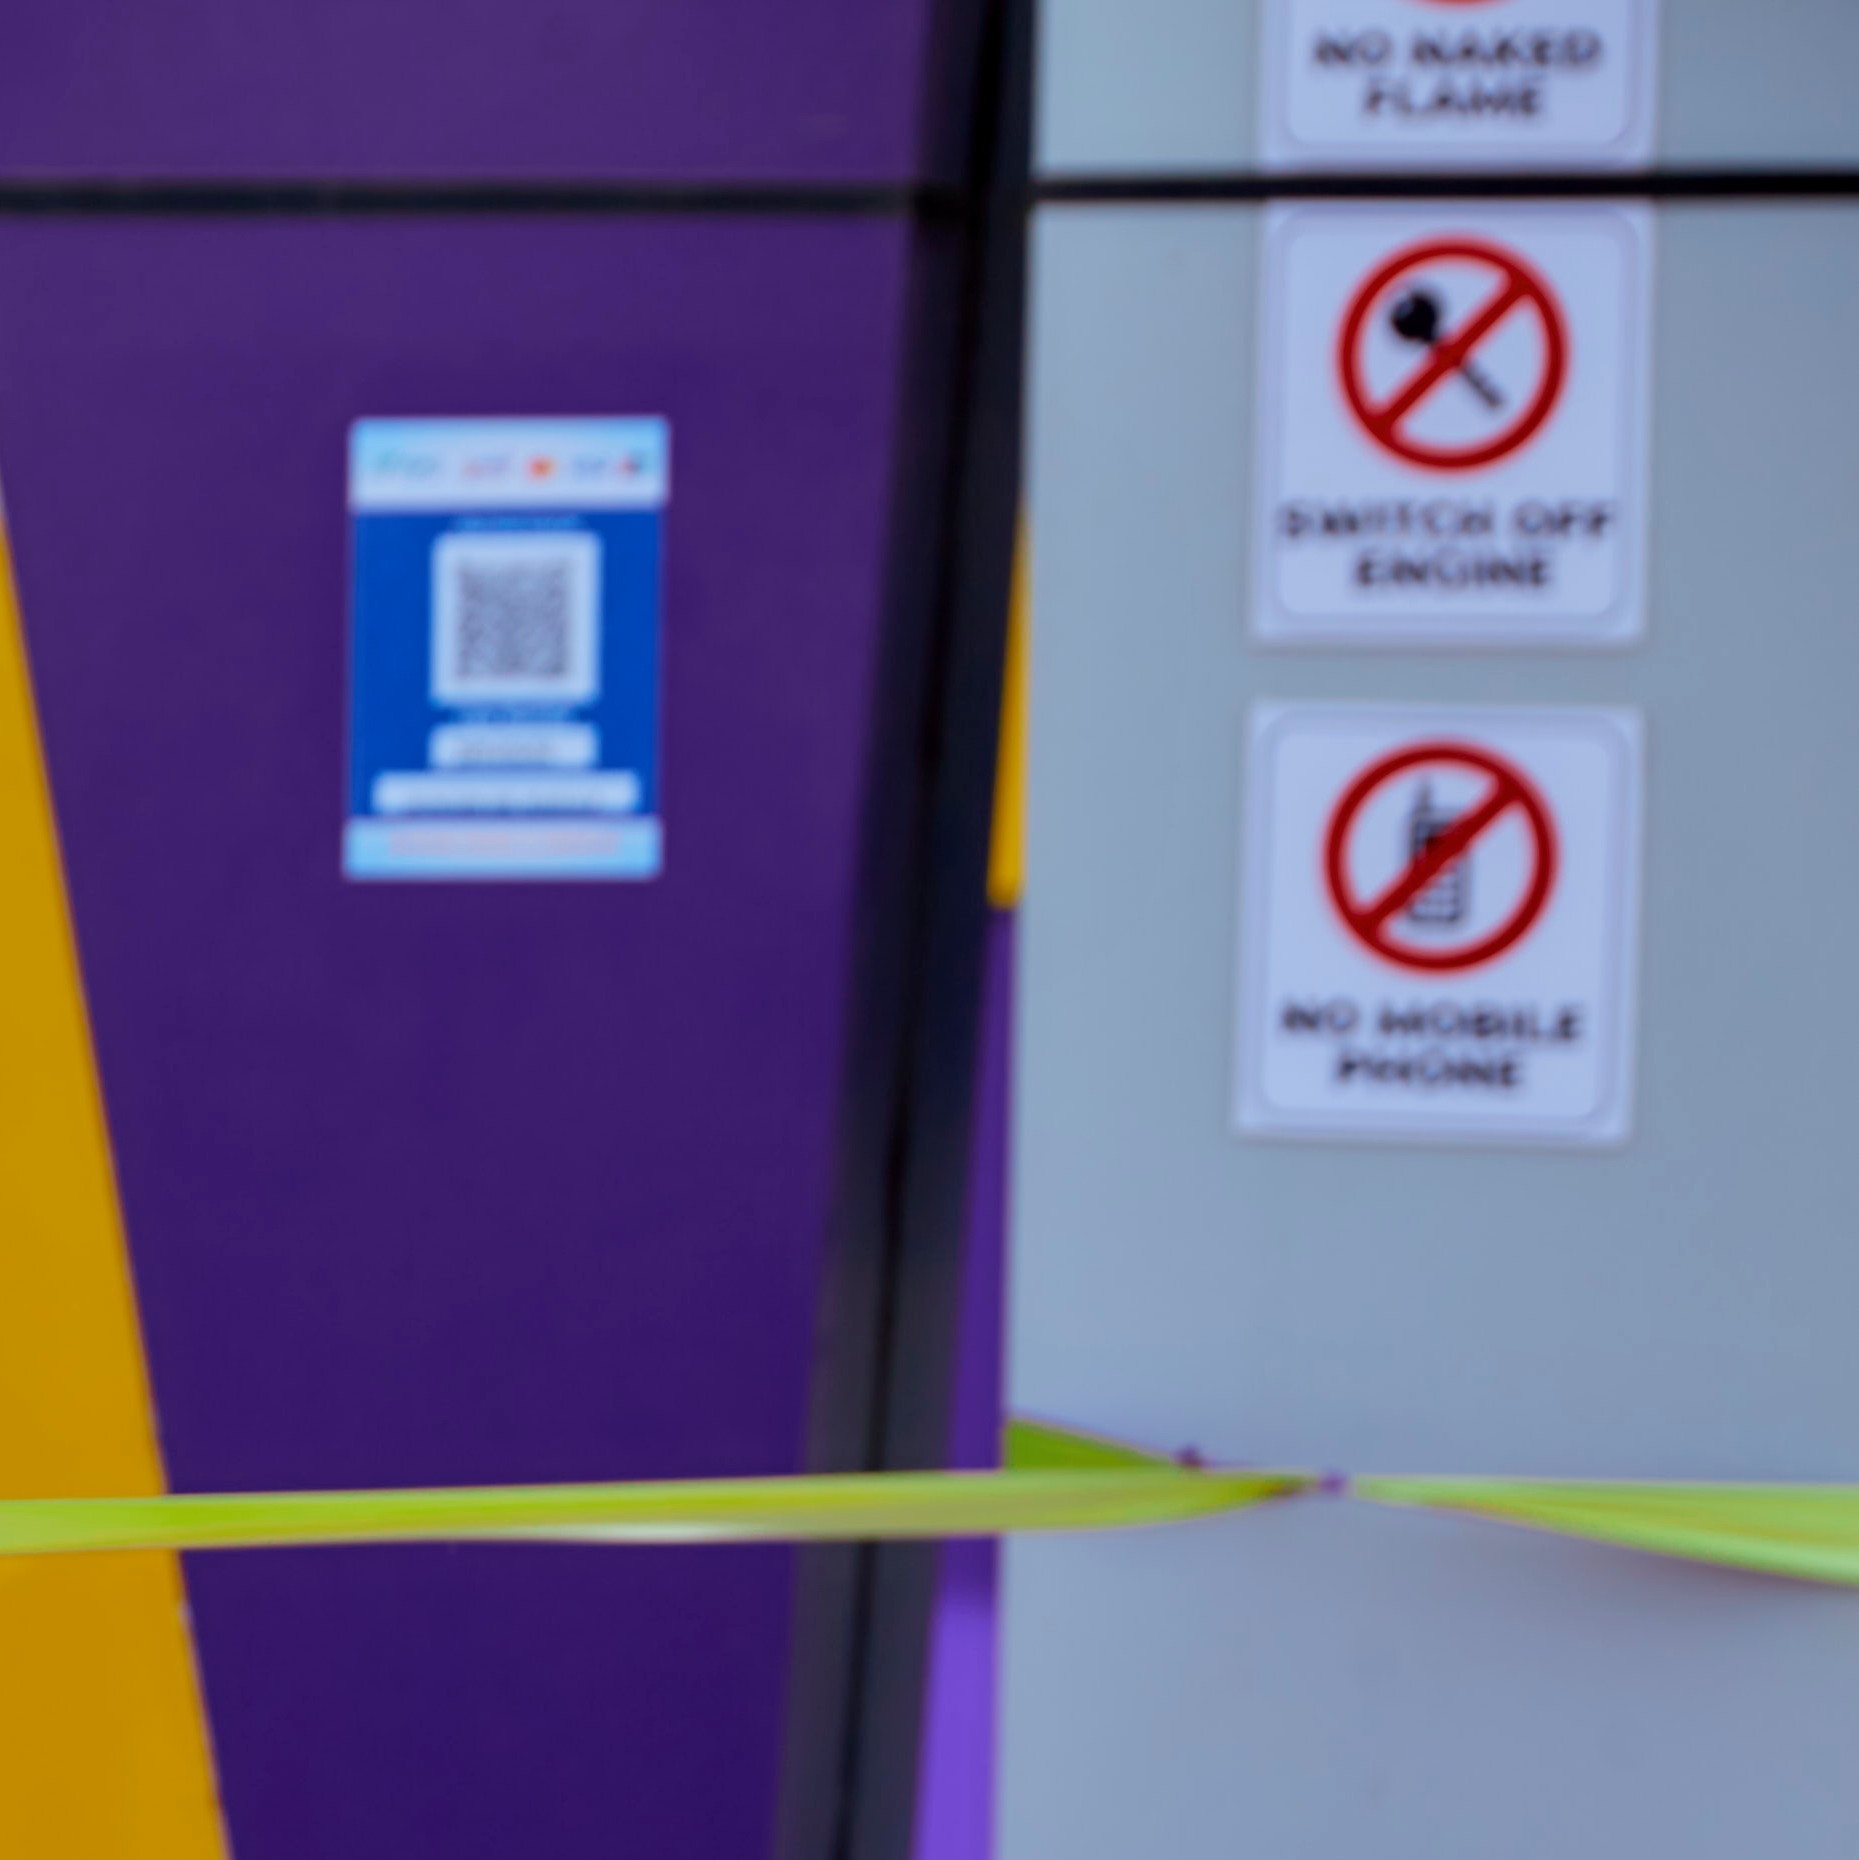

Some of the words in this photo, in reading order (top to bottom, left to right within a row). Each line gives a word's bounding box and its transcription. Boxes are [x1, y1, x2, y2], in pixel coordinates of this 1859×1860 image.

[1312, 28, 1393, 68] NO
[1411, 28, 1603, 70] NAKED
[1363, 77, 1543, 117] FLAME
[1279, 501, 1493, 540] SWITCH
[1515, 502, 1614, 538] OFF
[1354, 551, 1552, 589] ENGINE
[1280, 1000, 1358, 1034] NO
[1378, 1004, 1583, 1043] MOBILE
[1333, 1049, 1524, 1087] PHONE
